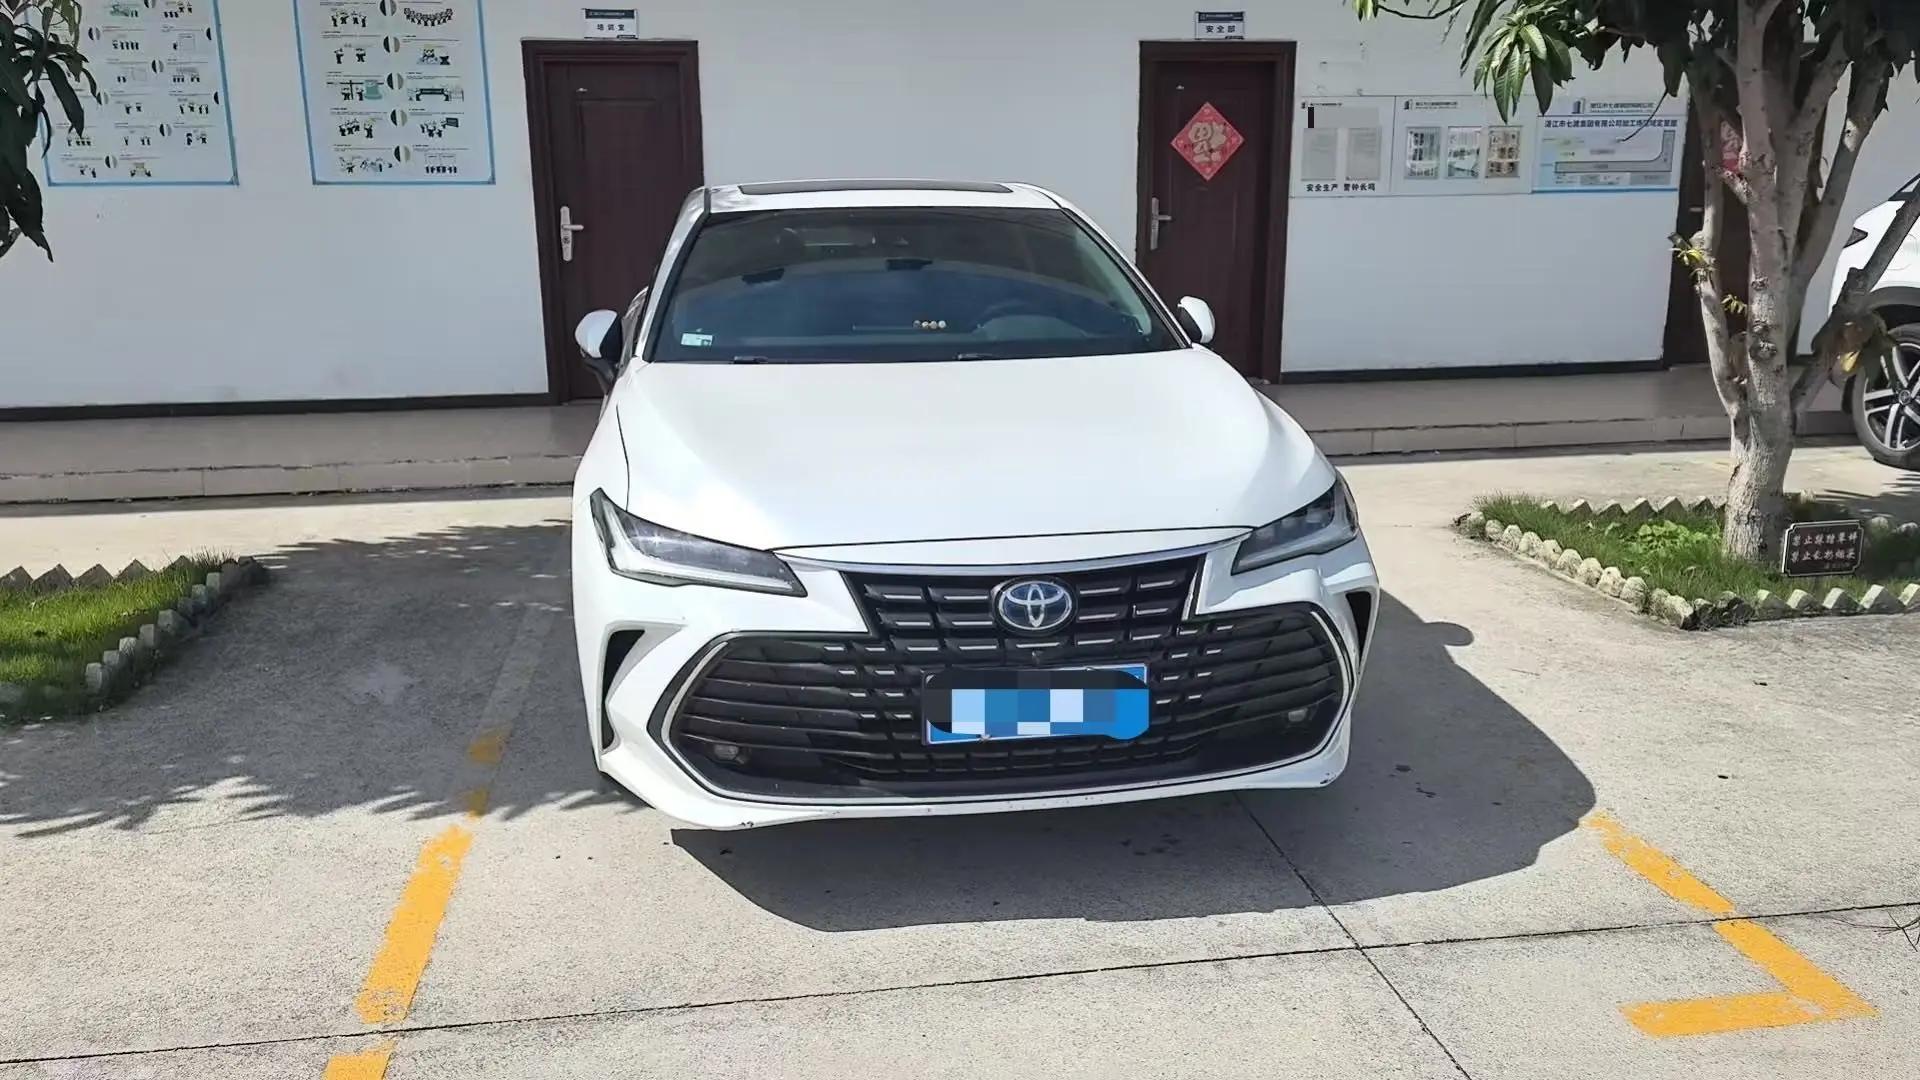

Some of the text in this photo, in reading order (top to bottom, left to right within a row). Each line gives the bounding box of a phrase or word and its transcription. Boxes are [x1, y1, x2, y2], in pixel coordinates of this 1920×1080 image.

[1205, 25, 1236, 33] 安全部
[1306, 183, 1376, 192] 安全生产 警钟长鸣
